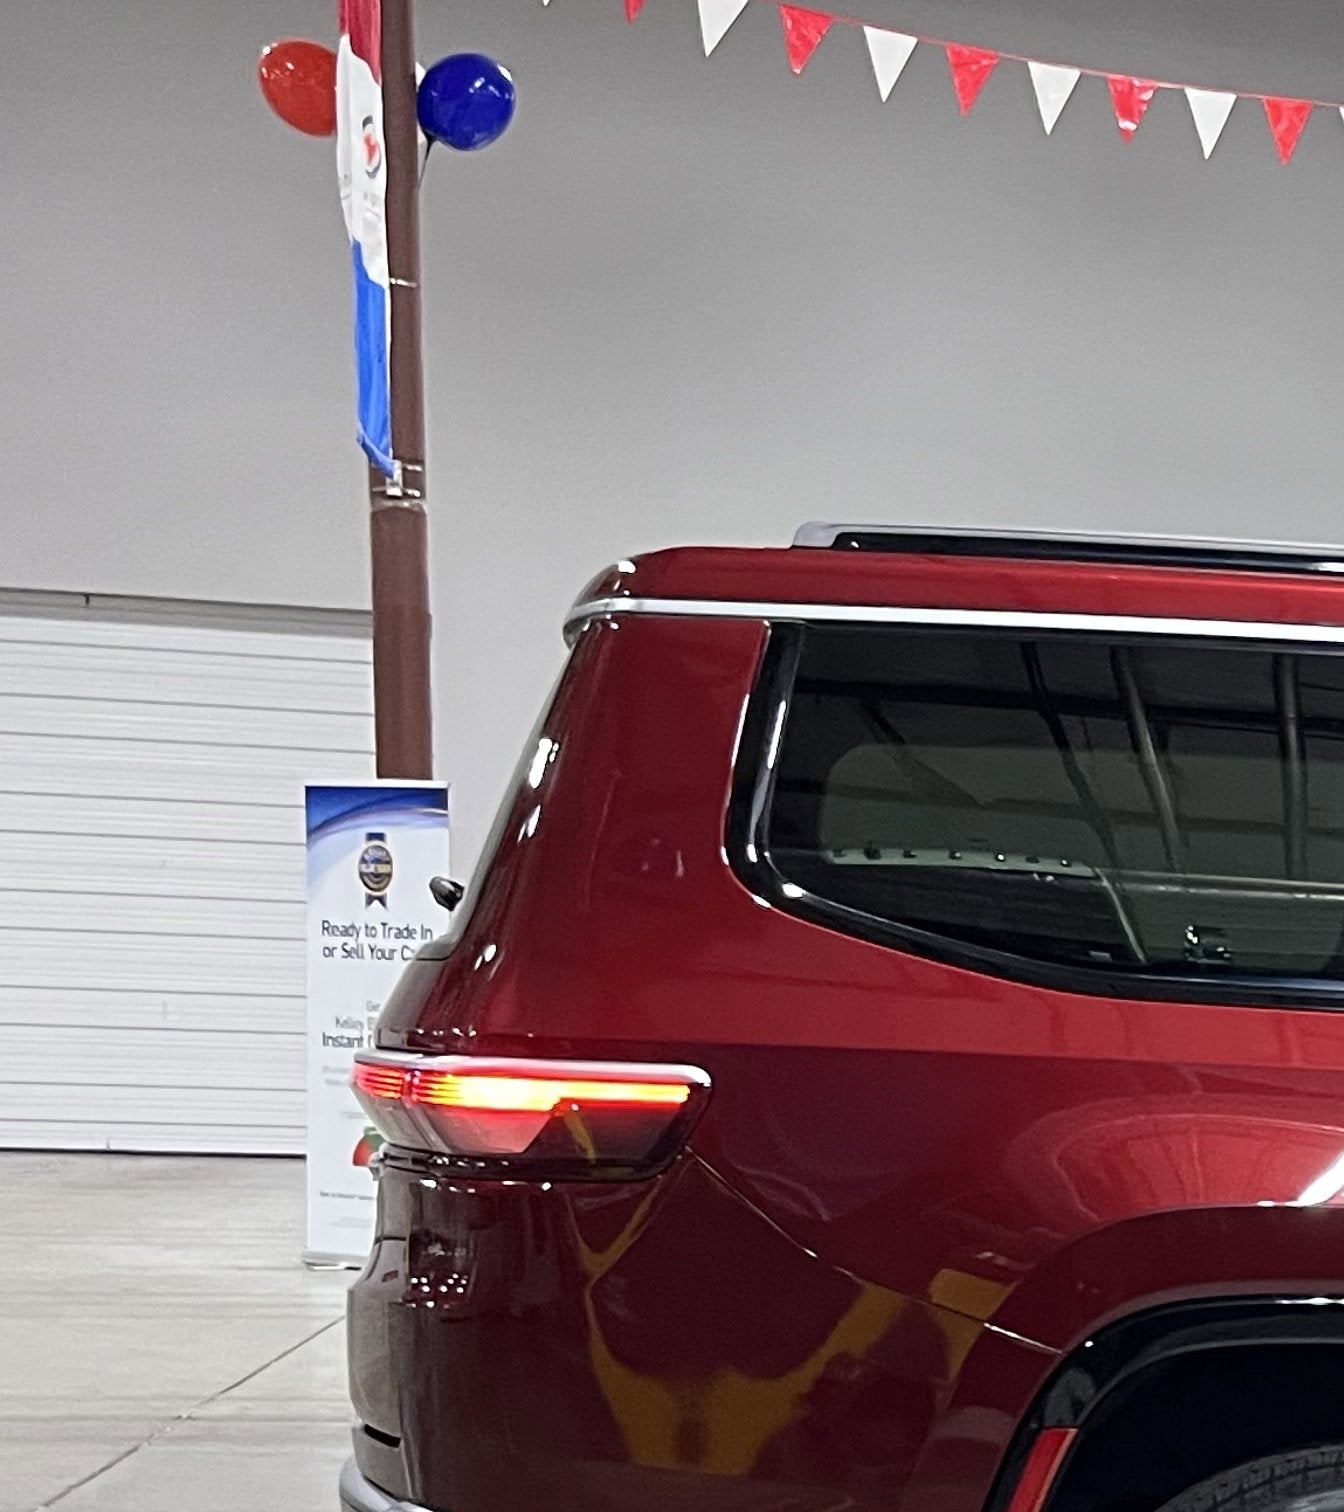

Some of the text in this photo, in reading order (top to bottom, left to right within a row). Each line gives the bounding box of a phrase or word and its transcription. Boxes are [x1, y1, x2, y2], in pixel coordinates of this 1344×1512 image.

[321, 919, 433, 942] Ready to Trade In
[322, 946, 337, 958] or
[341, 942, 364, 960] Sell
[368, 943, 397, 960] Your
[322, 1032, 364, 1048] Instant
